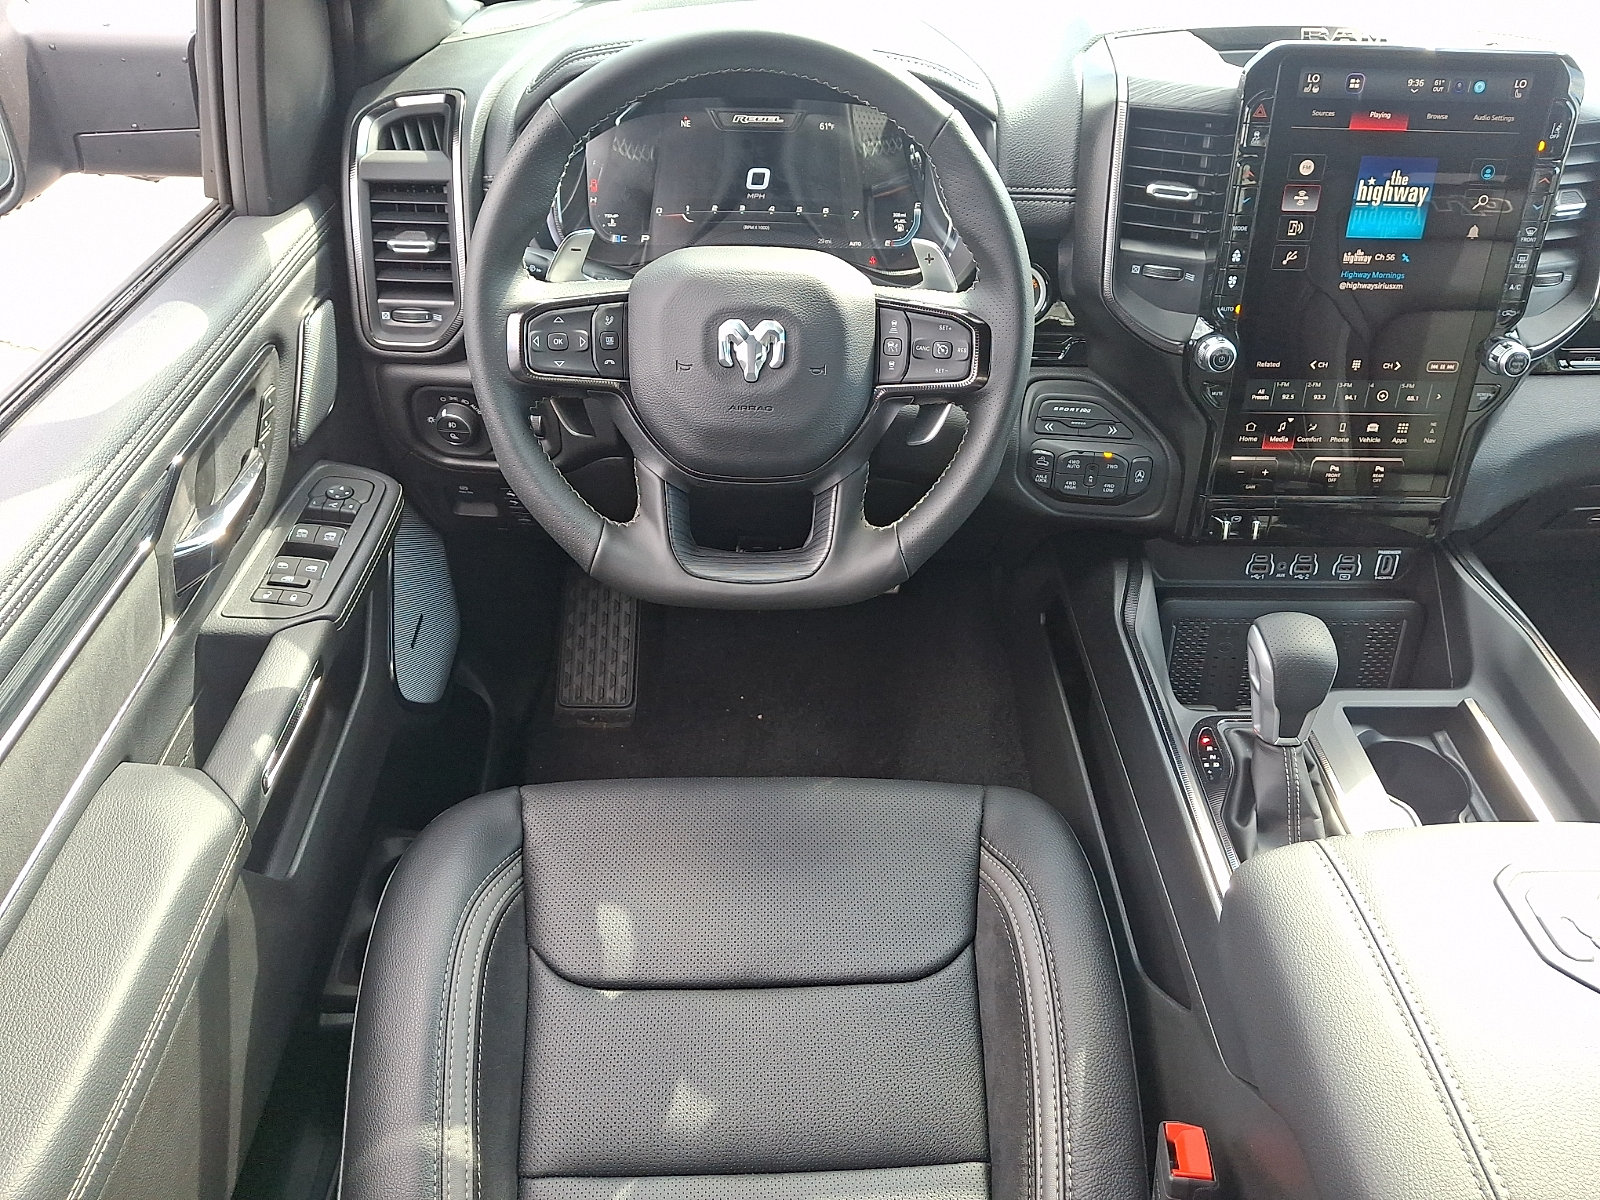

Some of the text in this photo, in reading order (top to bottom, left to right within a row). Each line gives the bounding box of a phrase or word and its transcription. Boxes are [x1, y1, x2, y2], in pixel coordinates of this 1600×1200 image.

[1307, 74, 1320, 83] LO
[1407, 78, 1424, 87] 9:36
[1514, 80, 1528, 88] LO
[1370, 111, 1392, 120] Playing
[1491, 115, 1515, 123] Settings
[680, 120, 691, 128] NE
[746, 168, 771, 190] 0
[1391, 170, 1409, 186] the
[1356, 180, 1430, 207] highway
[640, 234, 650, 242] P
[1343, 252, 1373, 264] highway
[1340, 270, 1406, 280] Highway Mornings
[1339, 282, 1404, 290] @highwaysiriusxm
[1256, 360, 1281, 368] Related
[1383, 362, 1394, 370] CH
[728, 404, 774, 412] AIRBAG
